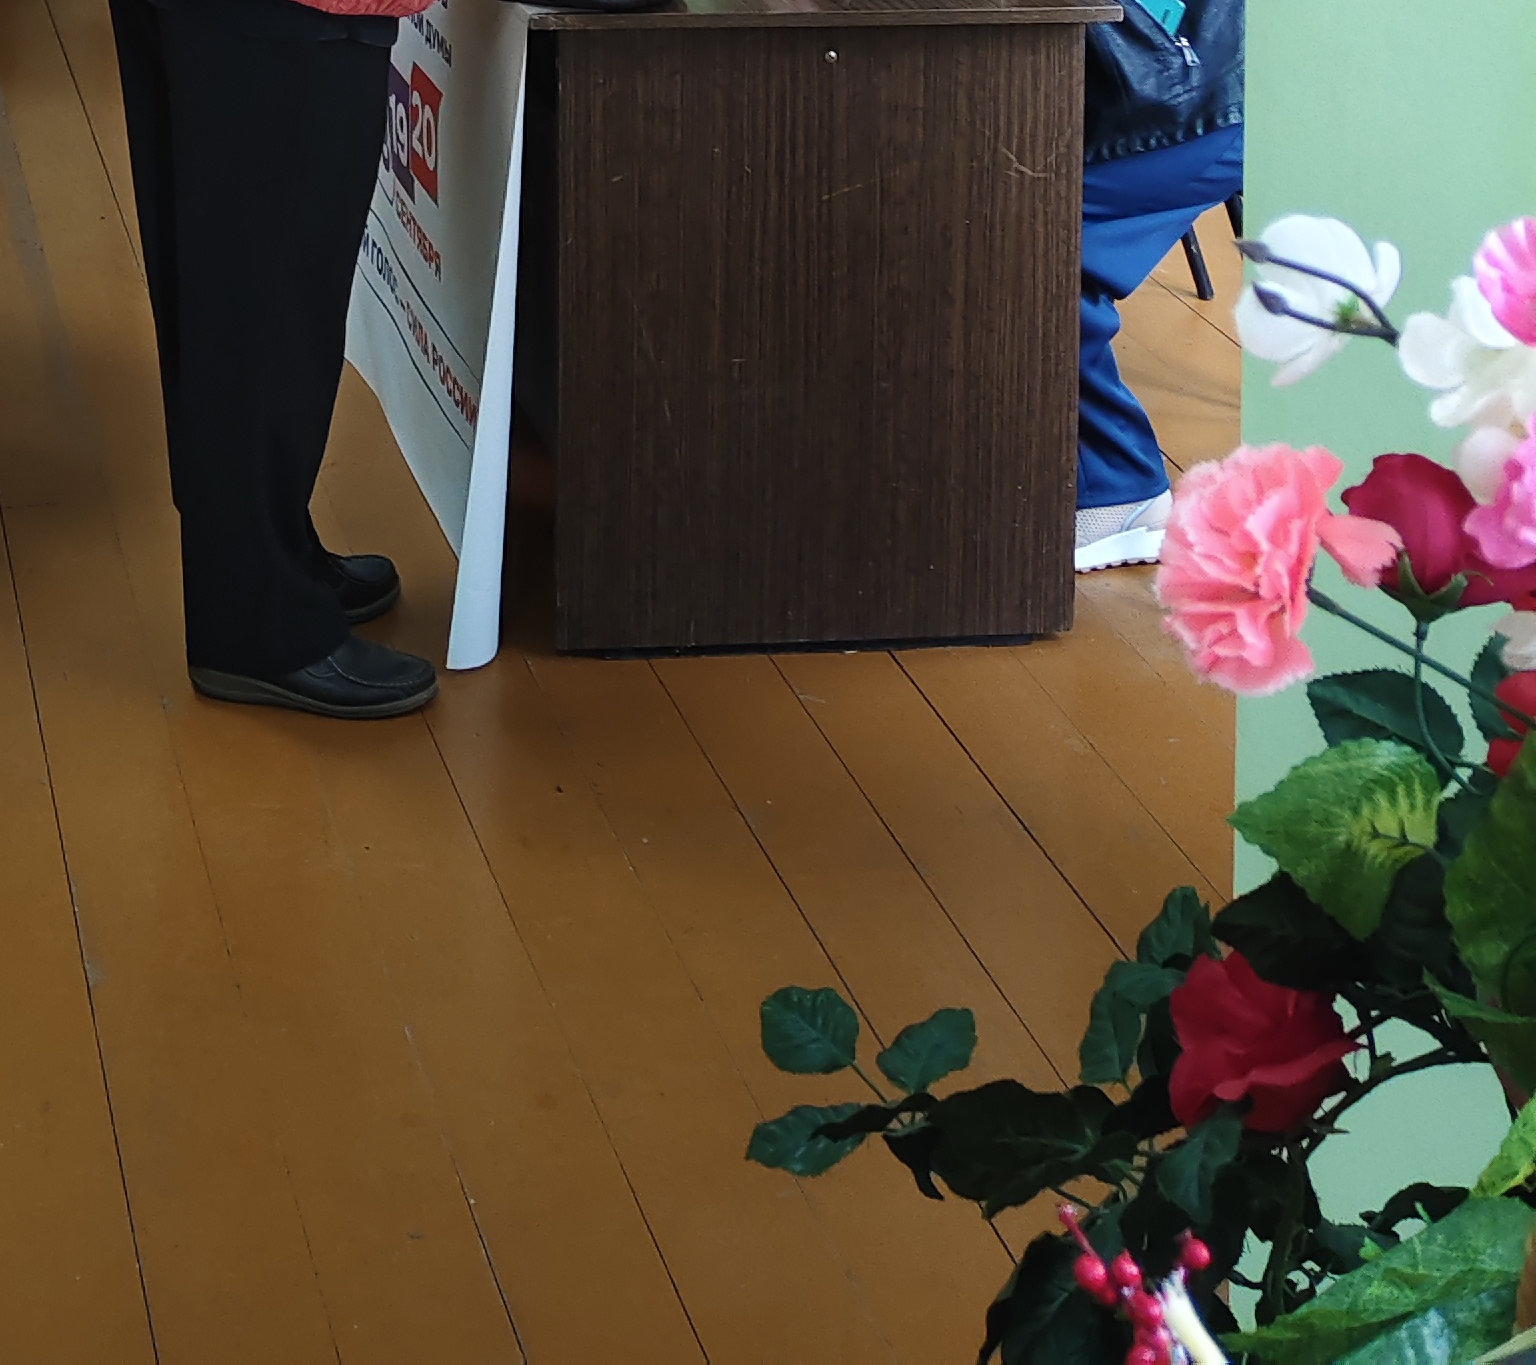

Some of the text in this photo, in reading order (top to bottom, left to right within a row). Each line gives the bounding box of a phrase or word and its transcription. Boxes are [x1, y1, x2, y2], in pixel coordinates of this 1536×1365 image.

[425, 18, 452, 68] ДУМЫ
[388, 93, 408, 167] 19
[411, 90, 436, 171] 20
[396, 190, 442, 283] СЕНТЯБРЯ
